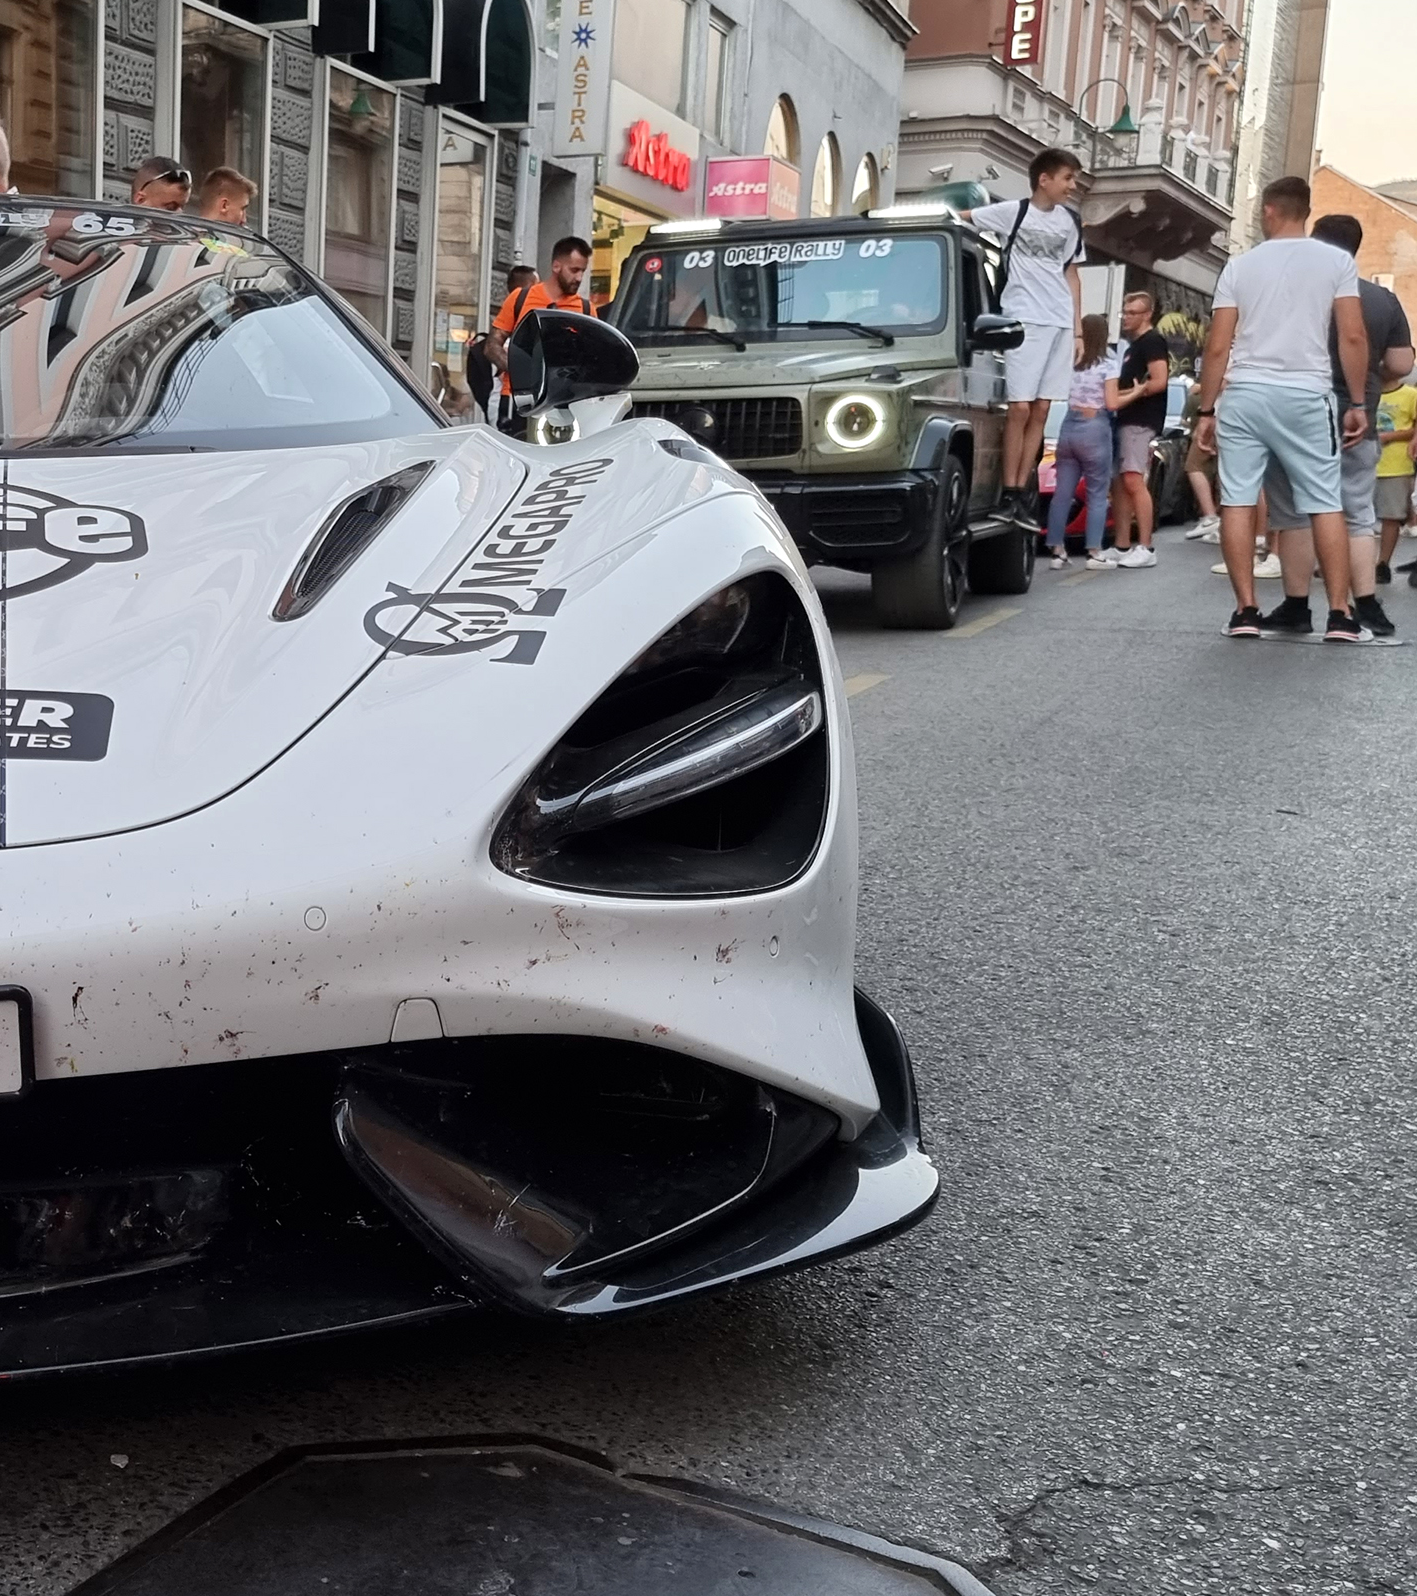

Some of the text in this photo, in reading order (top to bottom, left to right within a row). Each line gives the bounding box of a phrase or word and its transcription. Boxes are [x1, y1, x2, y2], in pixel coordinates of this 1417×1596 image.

[1011, 0, 1036, 60] PE
[568, 56, 590, 143] ASTRA
[624, 119, 690, 192] Astra
[708, 181, 768, 198] Astra
[72, 214, 136, 236] 65
[683, 250, 715, 269] 03
[858, 239, 894, 258] 03
[458, 458, 614, 588] MEGAPRO
